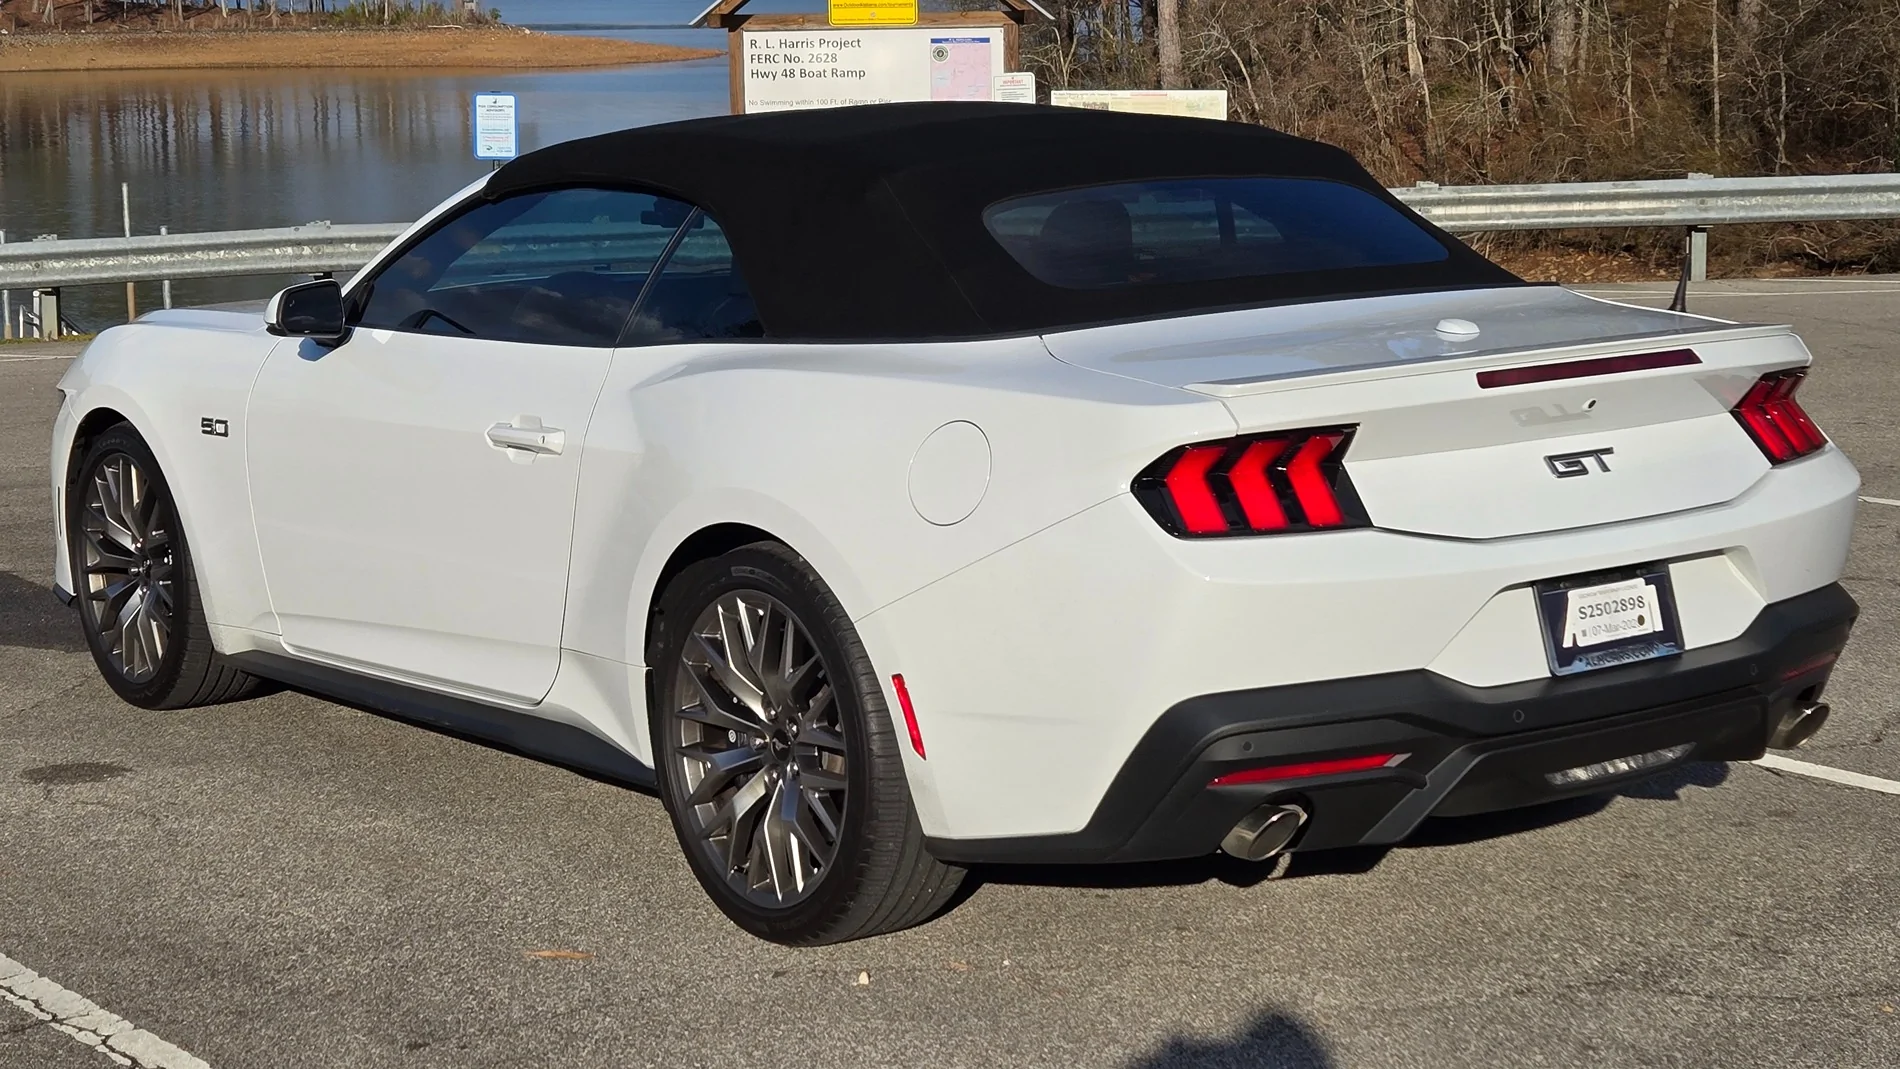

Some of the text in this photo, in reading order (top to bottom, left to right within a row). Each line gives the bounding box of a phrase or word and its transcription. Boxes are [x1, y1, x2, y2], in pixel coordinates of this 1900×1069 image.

[750, 37, 861, 50] R. L. Harris Project
[750, 52, 838, 64] FERC No. 2628
[751, 67, 866, 81] Hwy 48 Boat Ramp
[760, 99, 793, 107] Swimming
[1543, 446, 1614, 479] GT
[1578, 595, 1645, 620] S2502898
